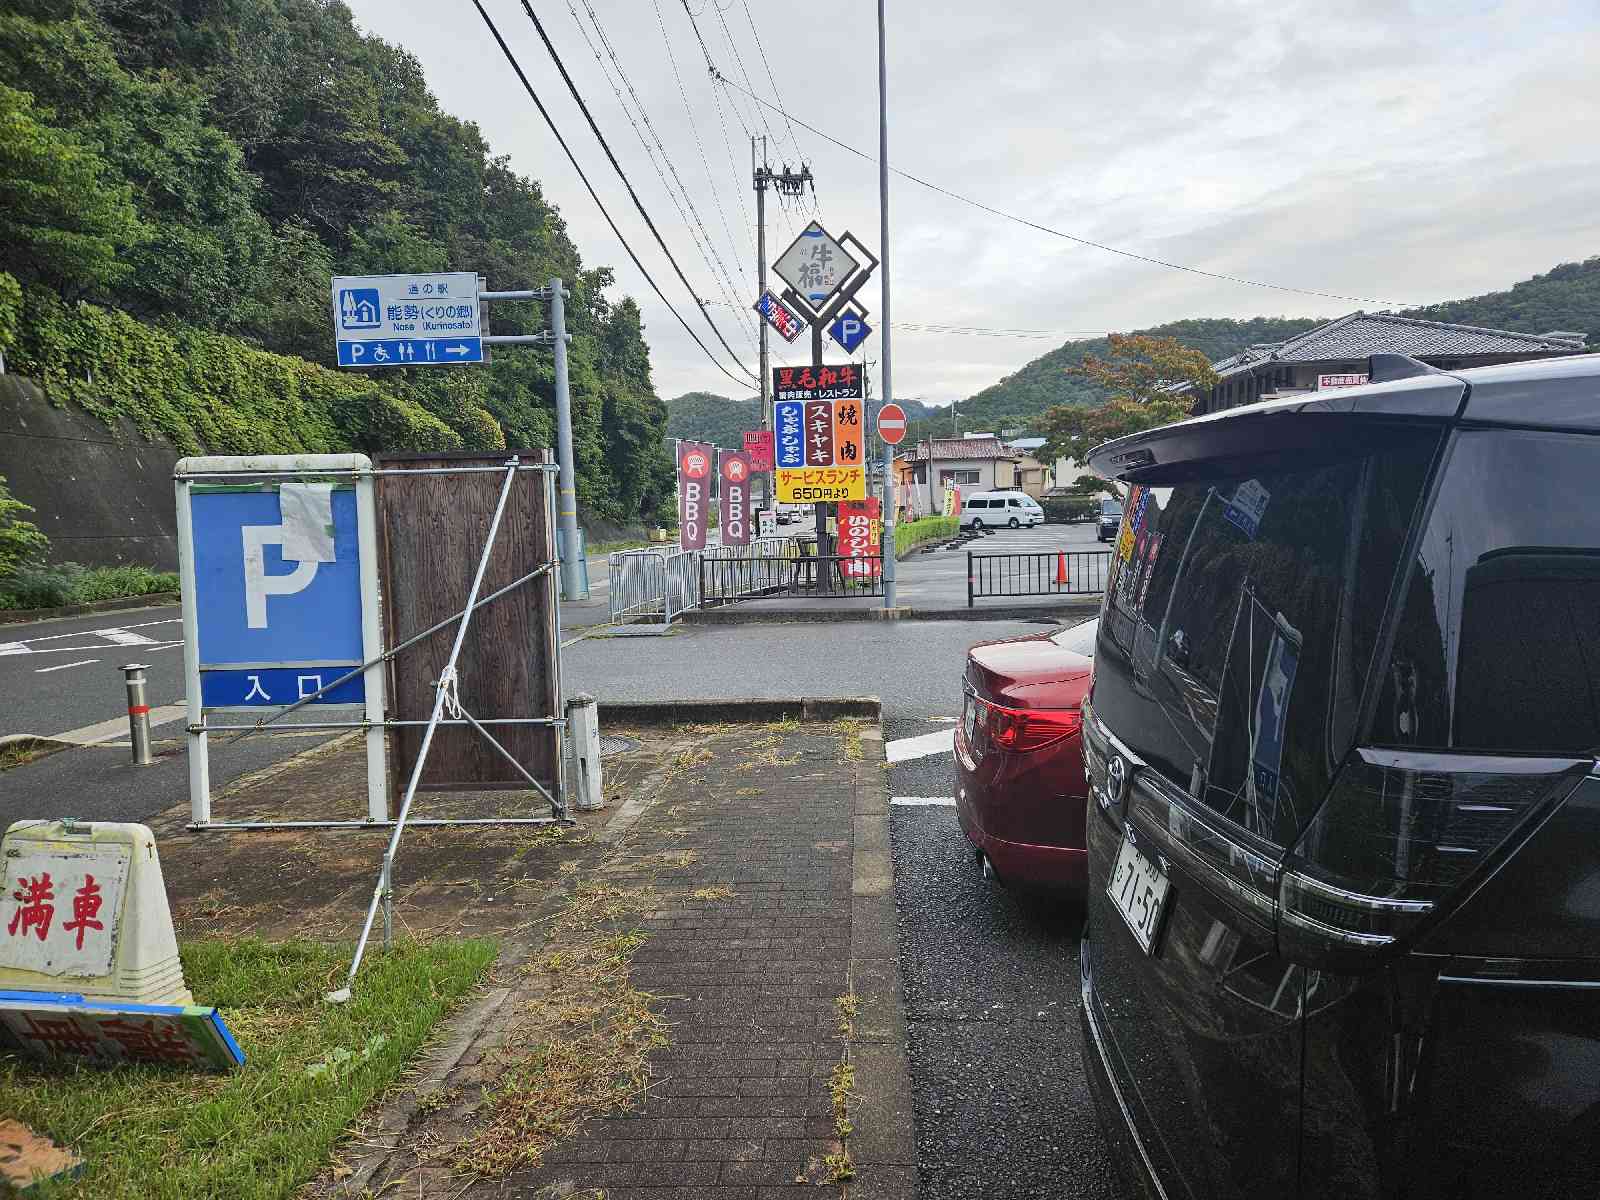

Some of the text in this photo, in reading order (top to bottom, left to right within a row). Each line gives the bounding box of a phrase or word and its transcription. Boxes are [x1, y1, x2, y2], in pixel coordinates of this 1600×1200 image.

[408, 282, 449, 296] 道の駅
[842, 319, 860, 344] P
[352, 344, 365, 363] P
[779, 367, 858, 389] 黒毛和牛
[809, 405, 831, 463] スキヤキ
[838, 404, 858, 461] 焼肉
[780, 470, 861, 486] サービスランチ
[792, 488, 849, 500] 650円より
[685, 483, 701, 541] BBQ
[728, 487, 743, 538] BBQ
[241, 524, 319, 629] P
[244, 674, 323, 700] 入口
[7, 872, 105, 951] 満車
